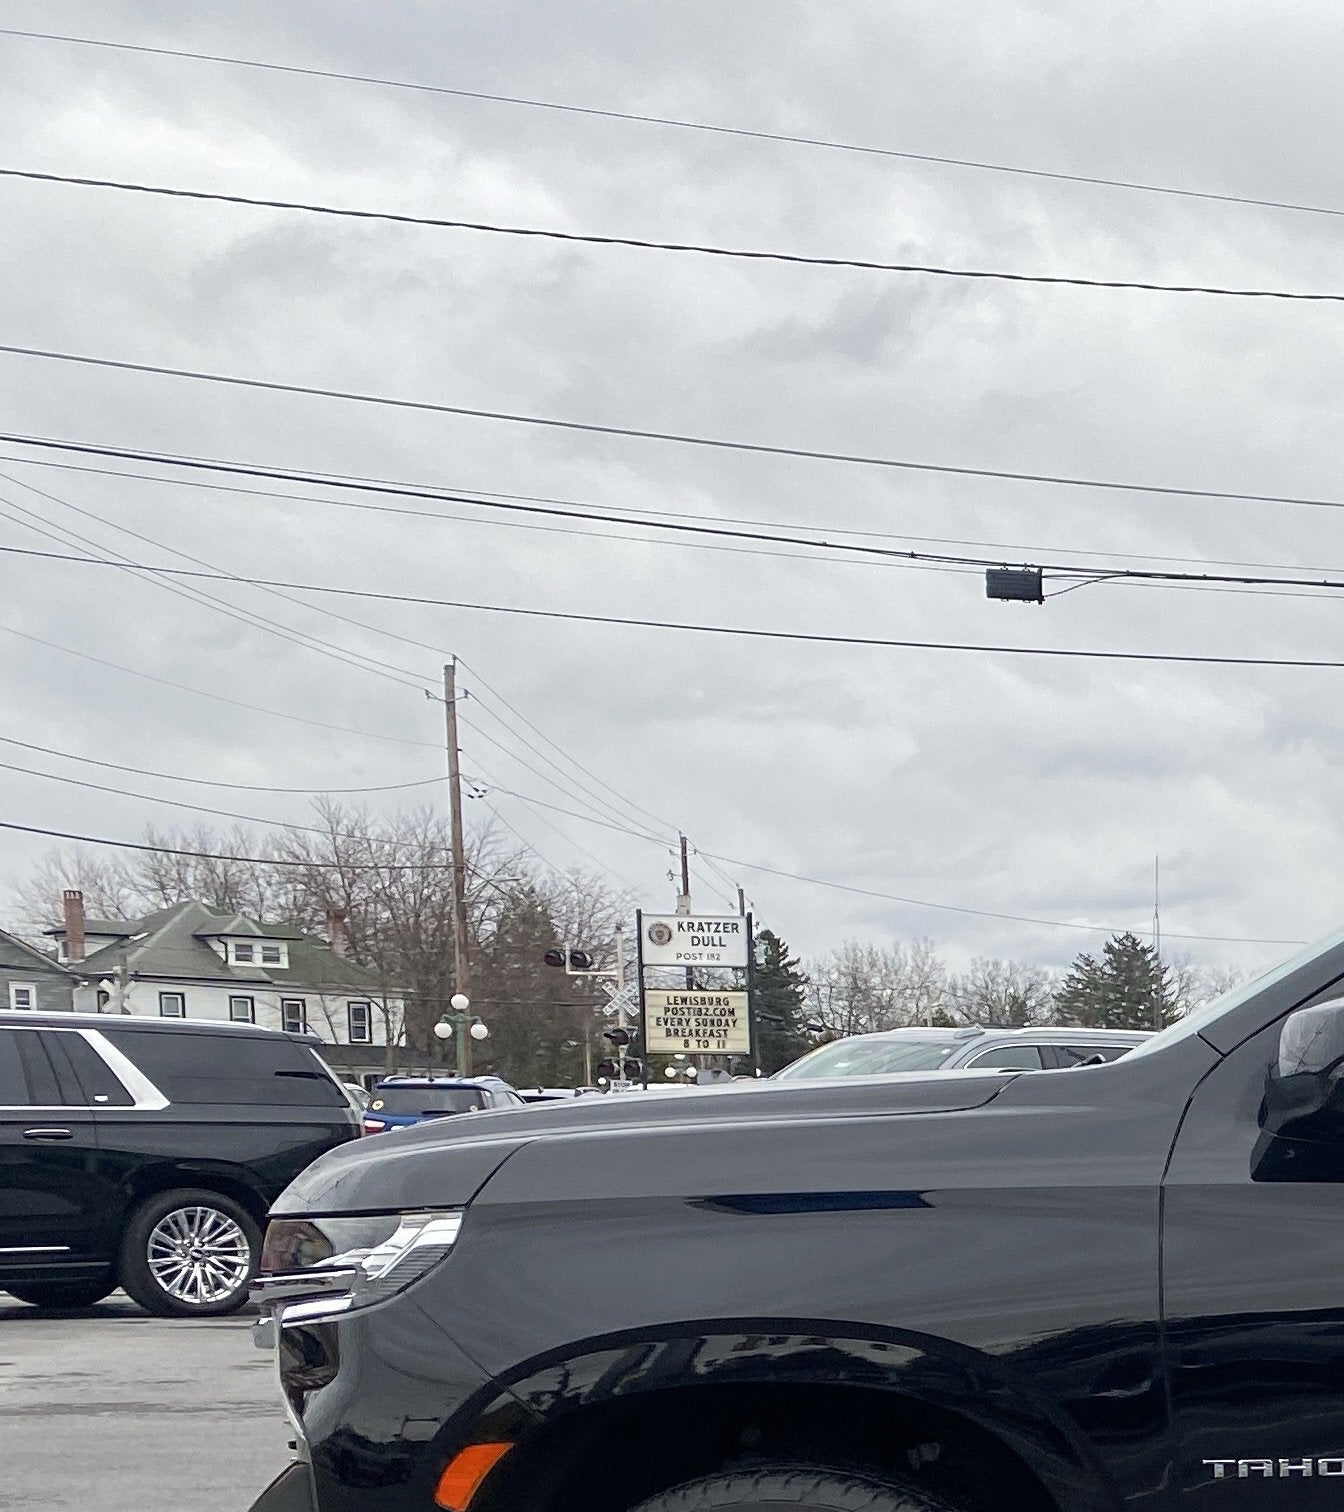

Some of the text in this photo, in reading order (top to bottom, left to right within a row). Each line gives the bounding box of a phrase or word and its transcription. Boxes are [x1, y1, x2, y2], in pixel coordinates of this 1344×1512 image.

[677, 921, 740, 934] KRATZER
[691, 936, 727, 947] DULL
[676, 952, 721, 961] POST 182
[666, 996, 730, 1006] LEWISBURG
[656, 1017, 738, 1028] EVERY SUNDAY
[665, 1028, 729, 1038] BREAKFAST
[696, 1040, 710, 1049] TO
